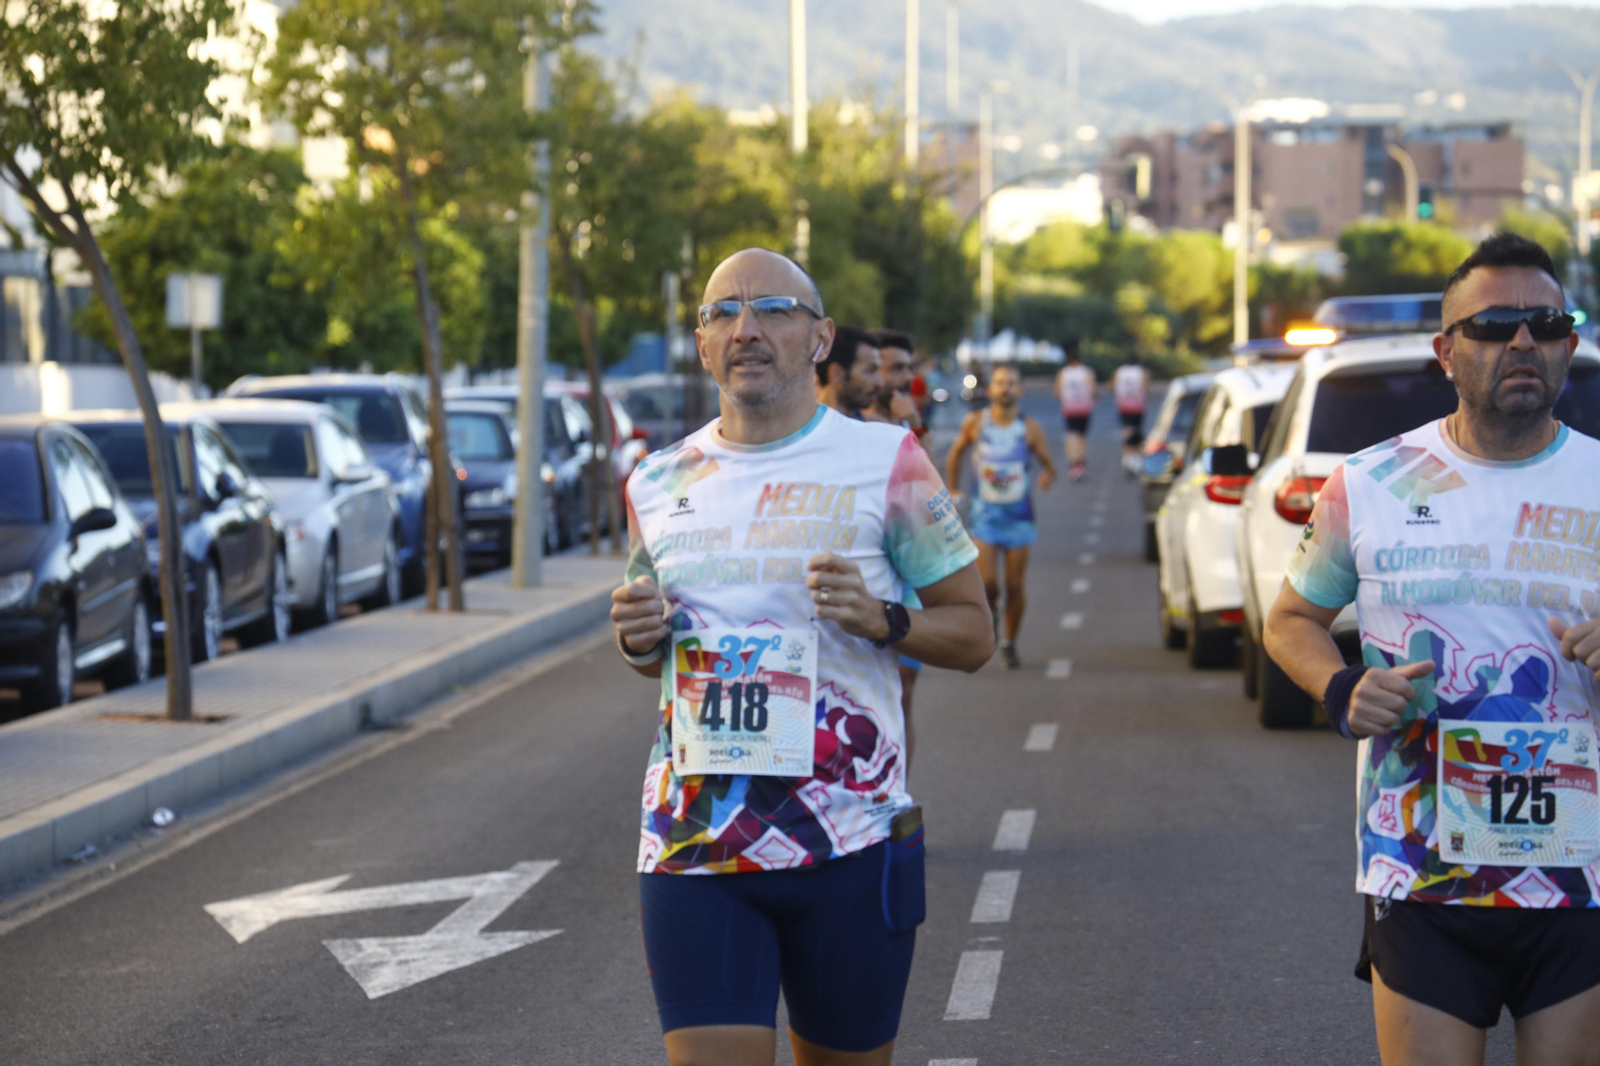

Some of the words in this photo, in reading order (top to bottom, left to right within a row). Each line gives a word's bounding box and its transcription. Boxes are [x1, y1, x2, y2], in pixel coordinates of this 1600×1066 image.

[755, 483, 856, 520] MEDIA
[743, 517, 859, 553] MARATÓN
[1375, 539, 1491, 573] CÓRDOBA
[1382, 571, 1521, 608] ALMODÓVAR
[1526, 580, 1575, 611] DEL
[700, 682, 769, 732] 418
[1487, 775, 1556, 825] 125
